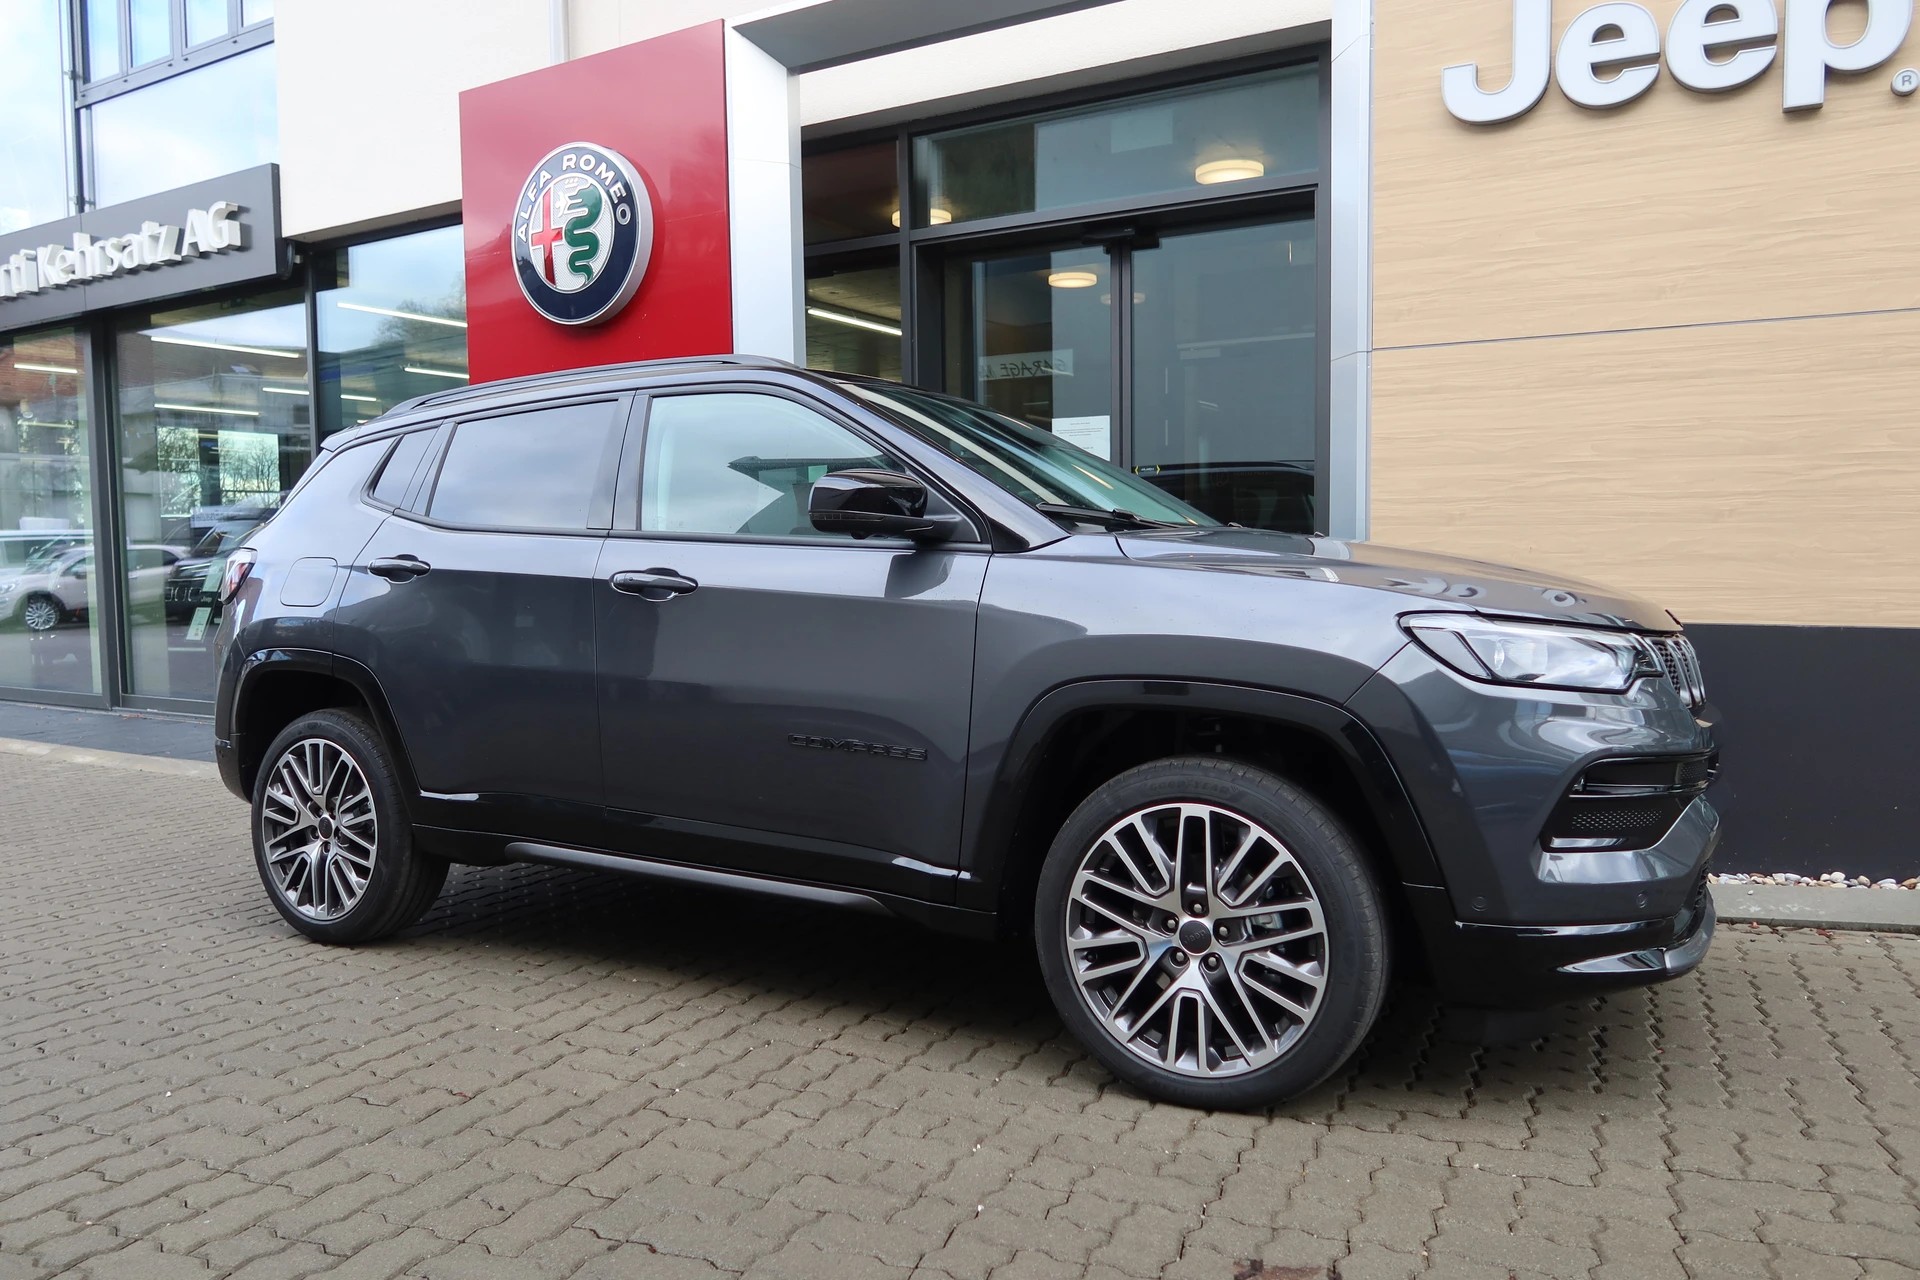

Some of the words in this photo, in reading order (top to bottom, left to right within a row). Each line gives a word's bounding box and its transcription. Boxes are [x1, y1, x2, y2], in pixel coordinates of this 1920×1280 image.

[1441, 0, 1913, 124] Jeep
[181, 200, 242, 257] AG
[517, 169, 552, 243] ALFA
[562, 153, 632, 225] ROMEO
